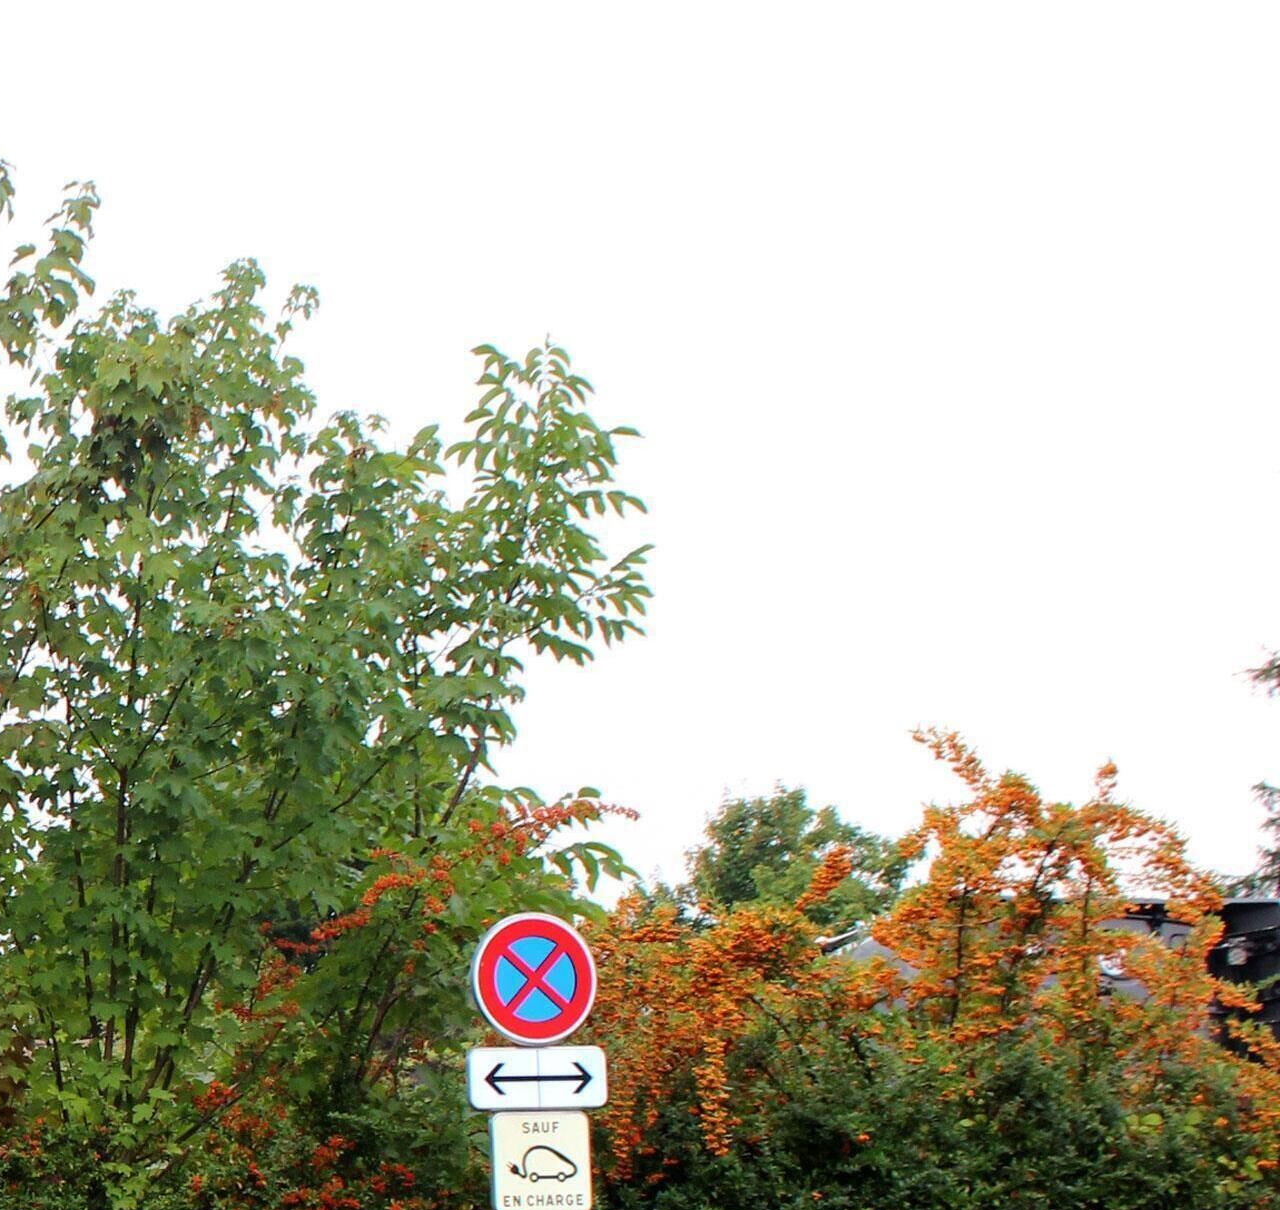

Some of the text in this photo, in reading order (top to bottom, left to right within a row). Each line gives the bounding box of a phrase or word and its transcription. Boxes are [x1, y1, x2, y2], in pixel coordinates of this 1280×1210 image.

[521, 1121, 560, 1134] SAUF
[502, 1194, 584, 1208] EN CHARGE
